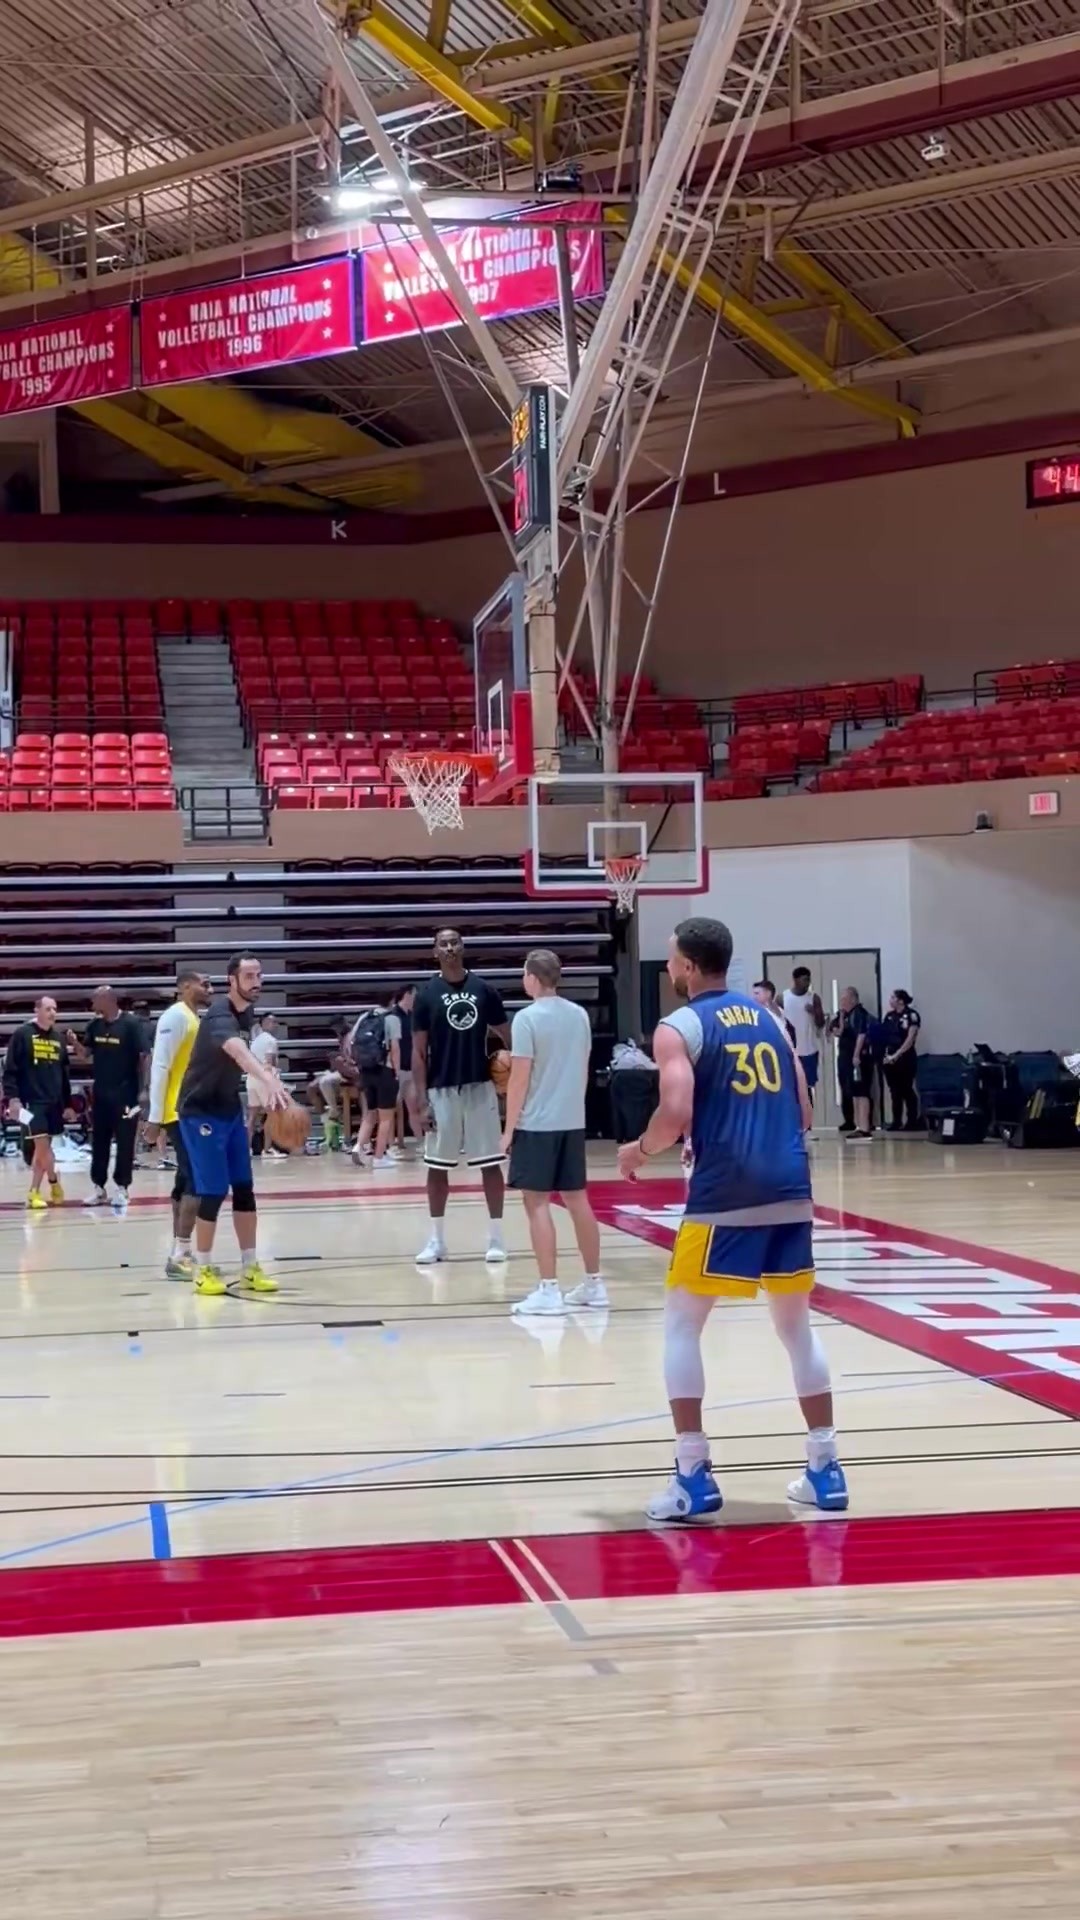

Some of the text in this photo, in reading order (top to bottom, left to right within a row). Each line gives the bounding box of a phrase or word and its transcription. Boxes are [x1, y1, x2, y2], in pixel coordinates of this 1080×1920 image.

[190, 285, 298, 323] NAIA NATIONAL
[466, 281, 499, 305] 997
[158, 298, 332, 349] VOLLEYBALL CHAMPIONS
[21, 328, 84, 358] NATIONAL
[227, 335, 262, 358] 1996
[38, 340, 115, 374] CHAMPIONS
[21, 375, 52, 397] 1995
[713, 472, 727, 495] L
[331, 519, 348, 539] K
[715, 1005, 760, 1028] CURRY
[725, 1041, 782, 1095] 30
